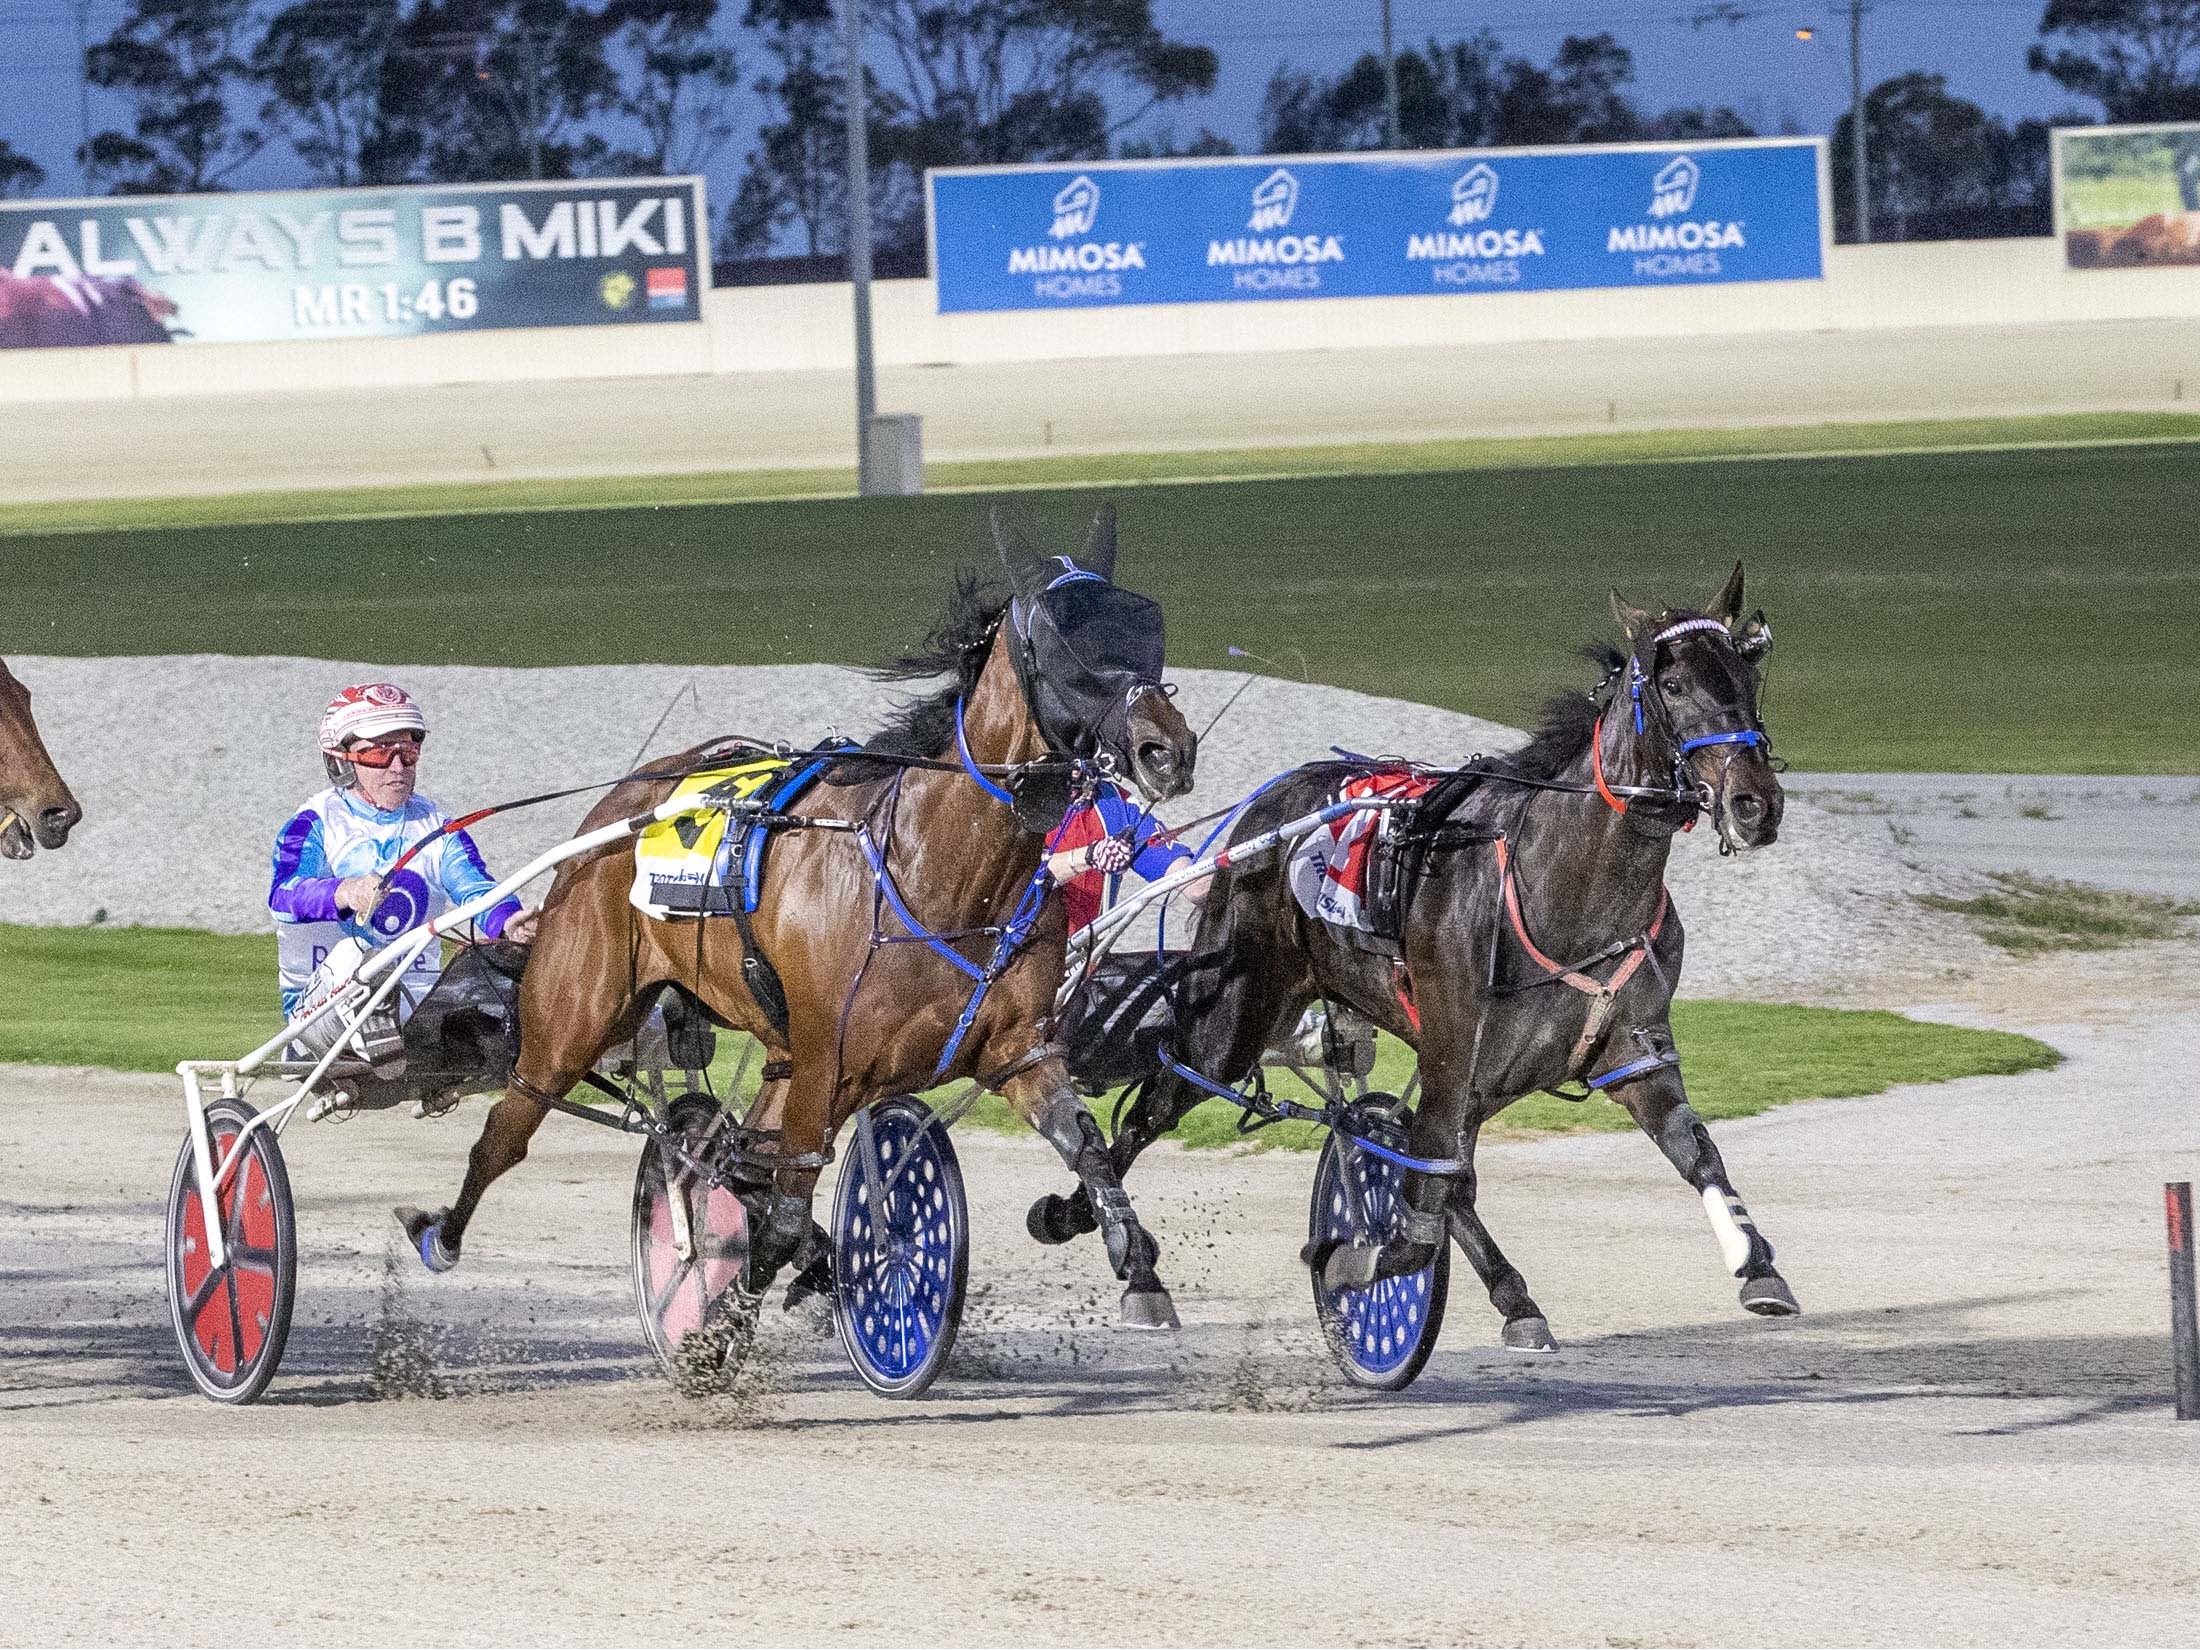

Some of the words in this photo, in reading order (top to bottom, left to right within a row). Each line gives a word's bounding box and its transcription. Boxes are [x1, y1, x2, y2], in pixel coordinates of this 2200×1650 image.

[12, 207, 399, 280] ALWAYS
[423, 205, 481, 263] B
[500, 198, 687, 260] MIKI
[1206, 236, 1346, 267] MIMOSA
[1406, 229, 1546, 261] MIMOSA
[1607, 222, 1746, 253] MIMOSA
[1008, 242, 1147, 274] MIMOSA
[1433, 260, 1521, 285] HOMES
[1633, 253, 1722, 277] HOMES
[1034, 274, 1122, 298] HOMES
[1233, 267, 1322, 290] HOMES
[294, 282, 371, 326] MR
[377, 276, 480, 323] 1:46
